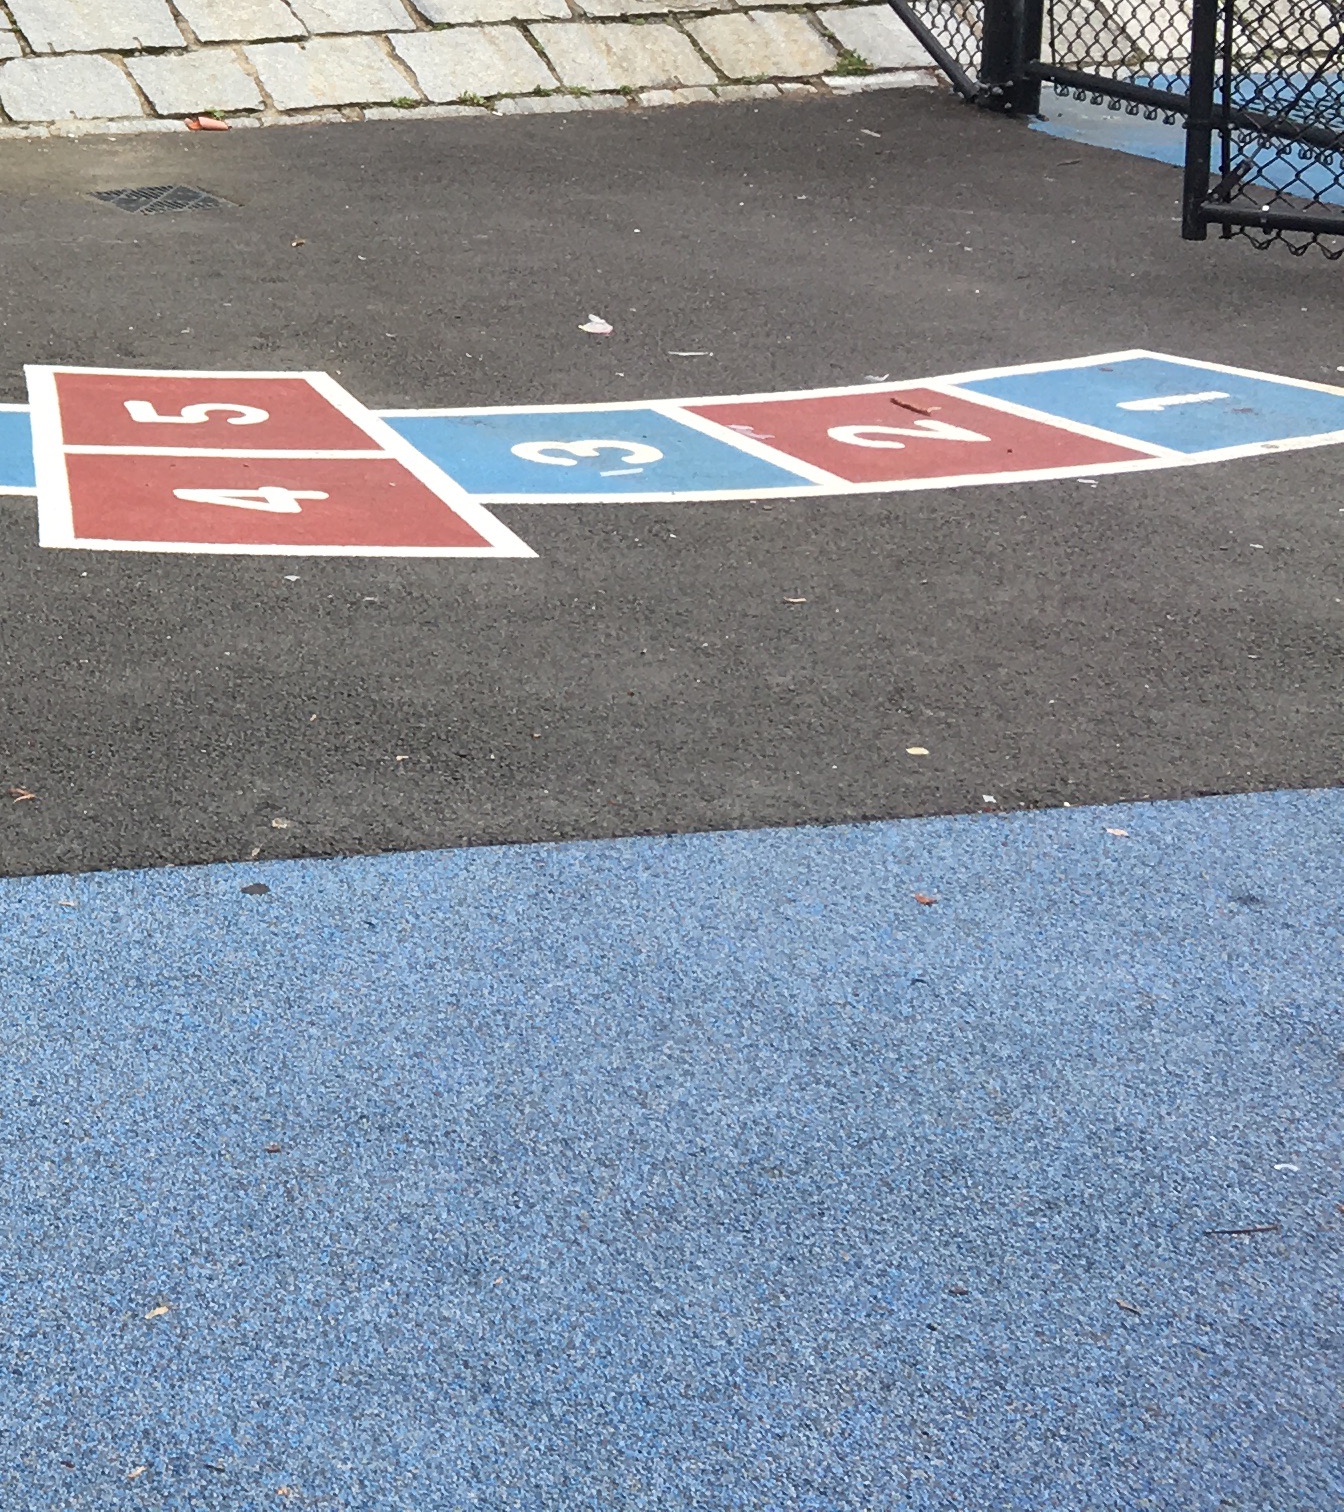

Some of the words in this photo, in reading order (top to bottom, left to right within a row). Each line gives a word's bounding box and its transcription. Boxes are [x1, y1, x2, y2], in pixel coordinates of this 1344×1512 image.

[123, 400, 269, 426] 5
[1116, 390, 1230, 412] 1
[826, 418, 992, 450] 2
[510, 438, 664, 466] 3
[172, 484, 329, 514] 4
